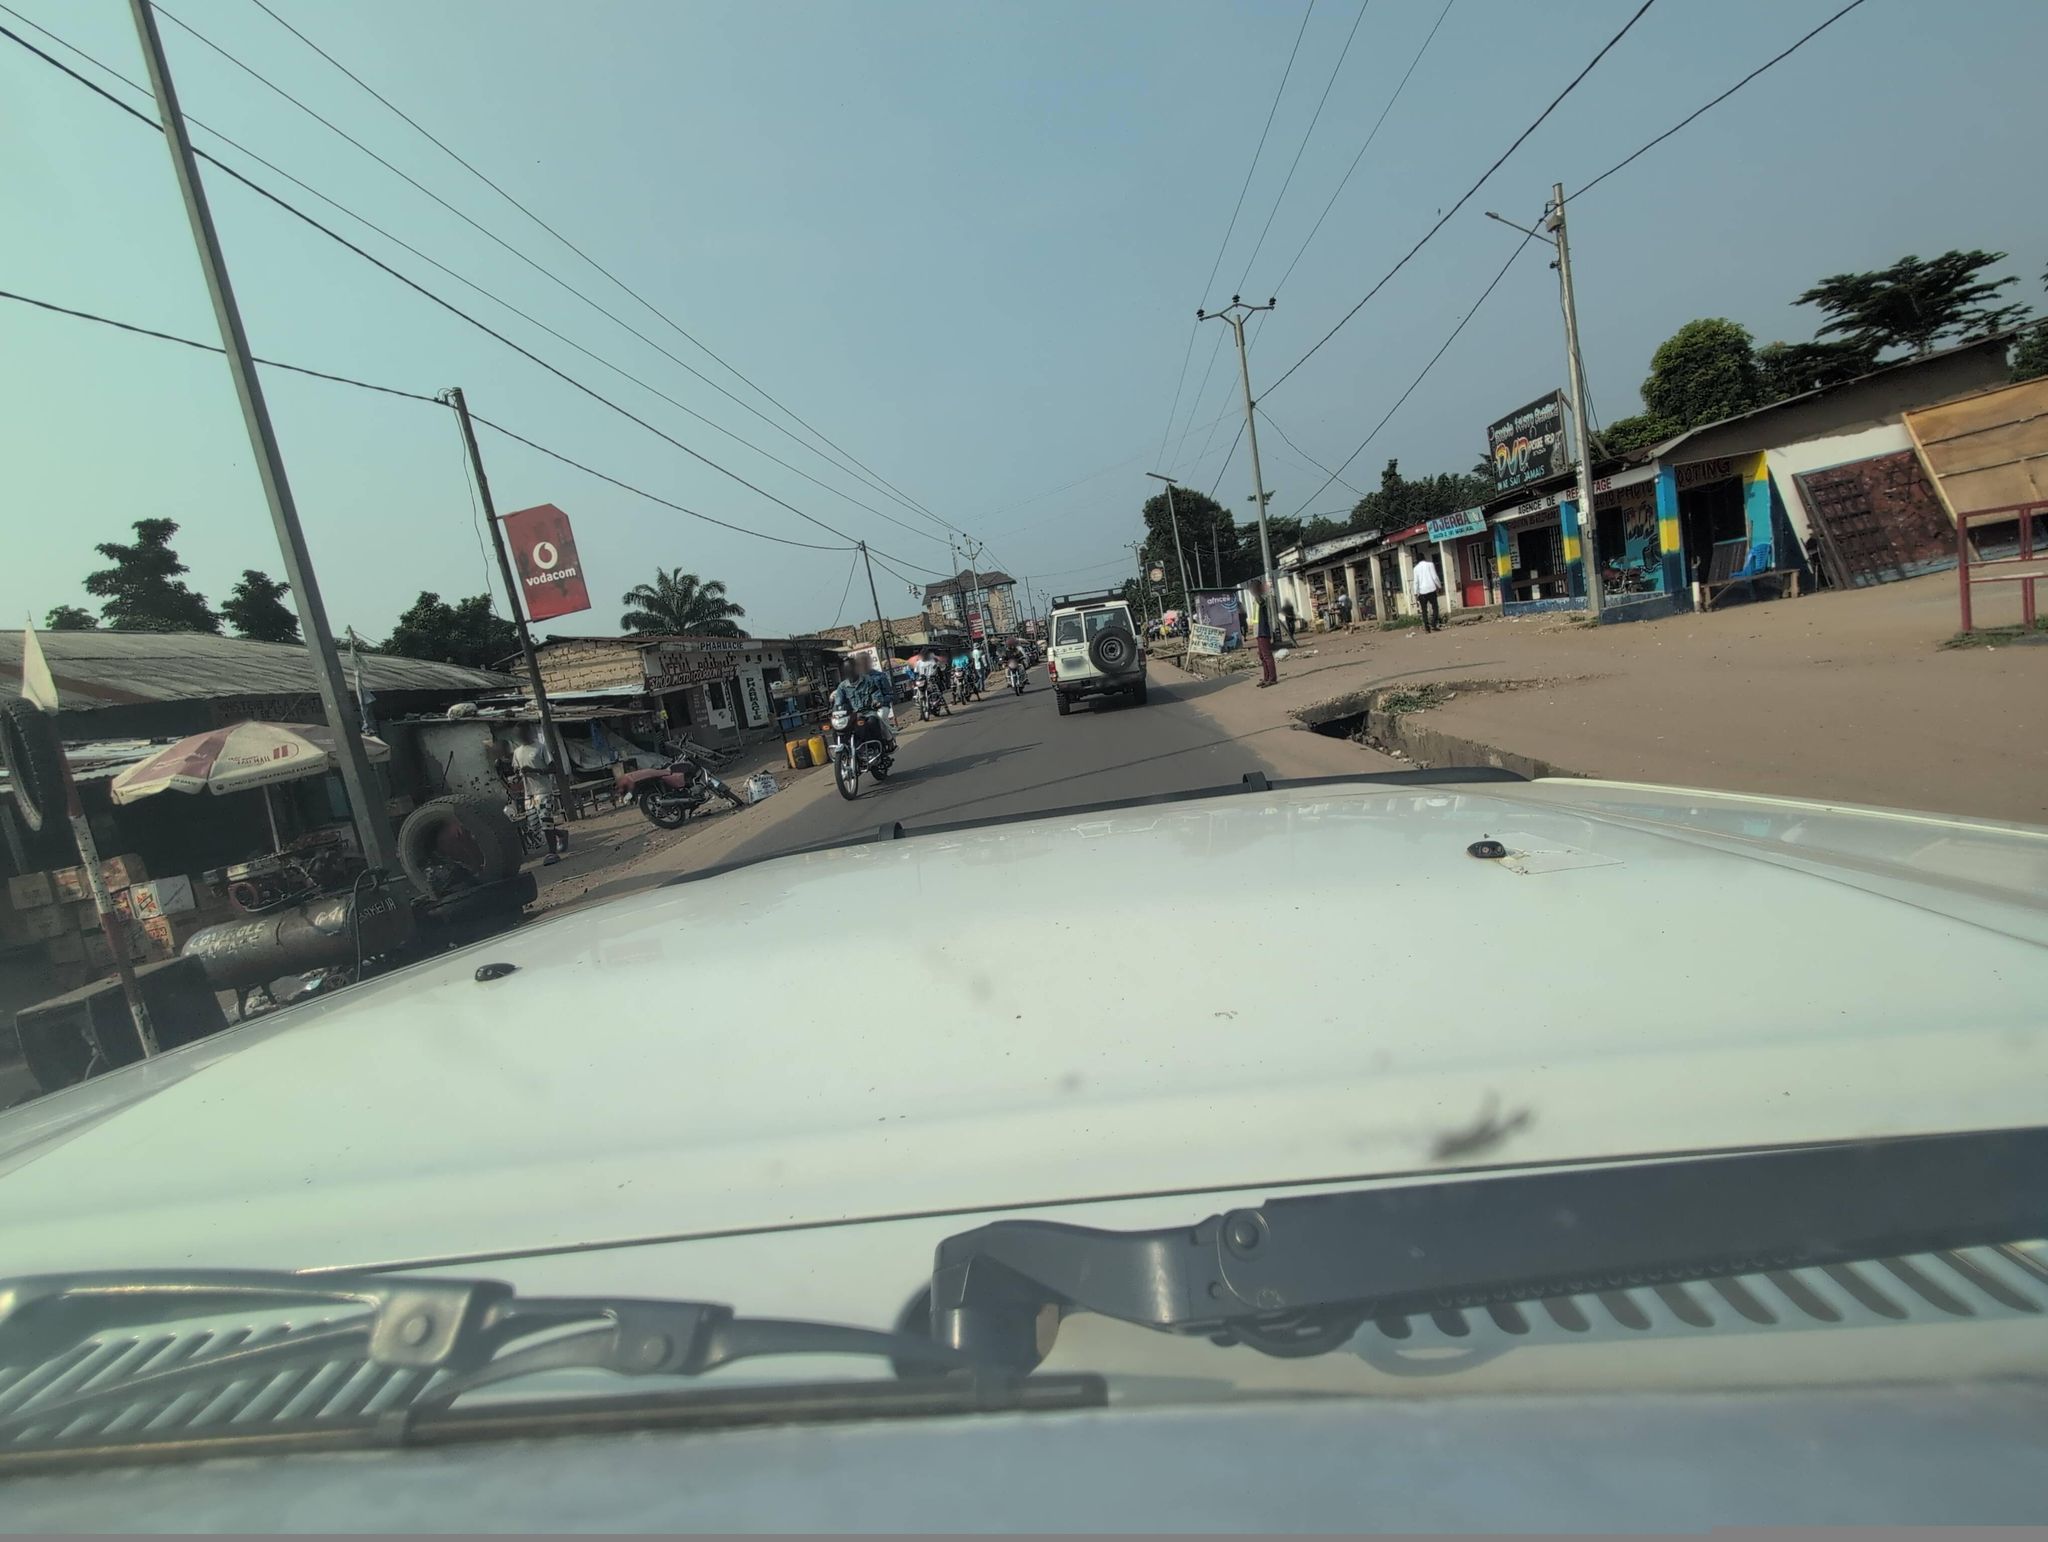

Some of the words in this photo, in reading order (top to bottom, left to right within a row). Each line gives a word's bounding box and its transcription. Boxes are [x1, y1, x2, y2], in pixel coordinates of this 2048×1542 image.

[1524, 465, 1545, 482] JAMAIS
[1677, 459, 1731, 488] OOTING
[1518, 501, 1542, 515] AGENCE
[1547, 496, 1555, 506] DE
[1566, 478, 1612, 500] REPTAGE
[1432, 512, 1471, 533] DJERBA
[526, 567, 576, 586] vodacom
